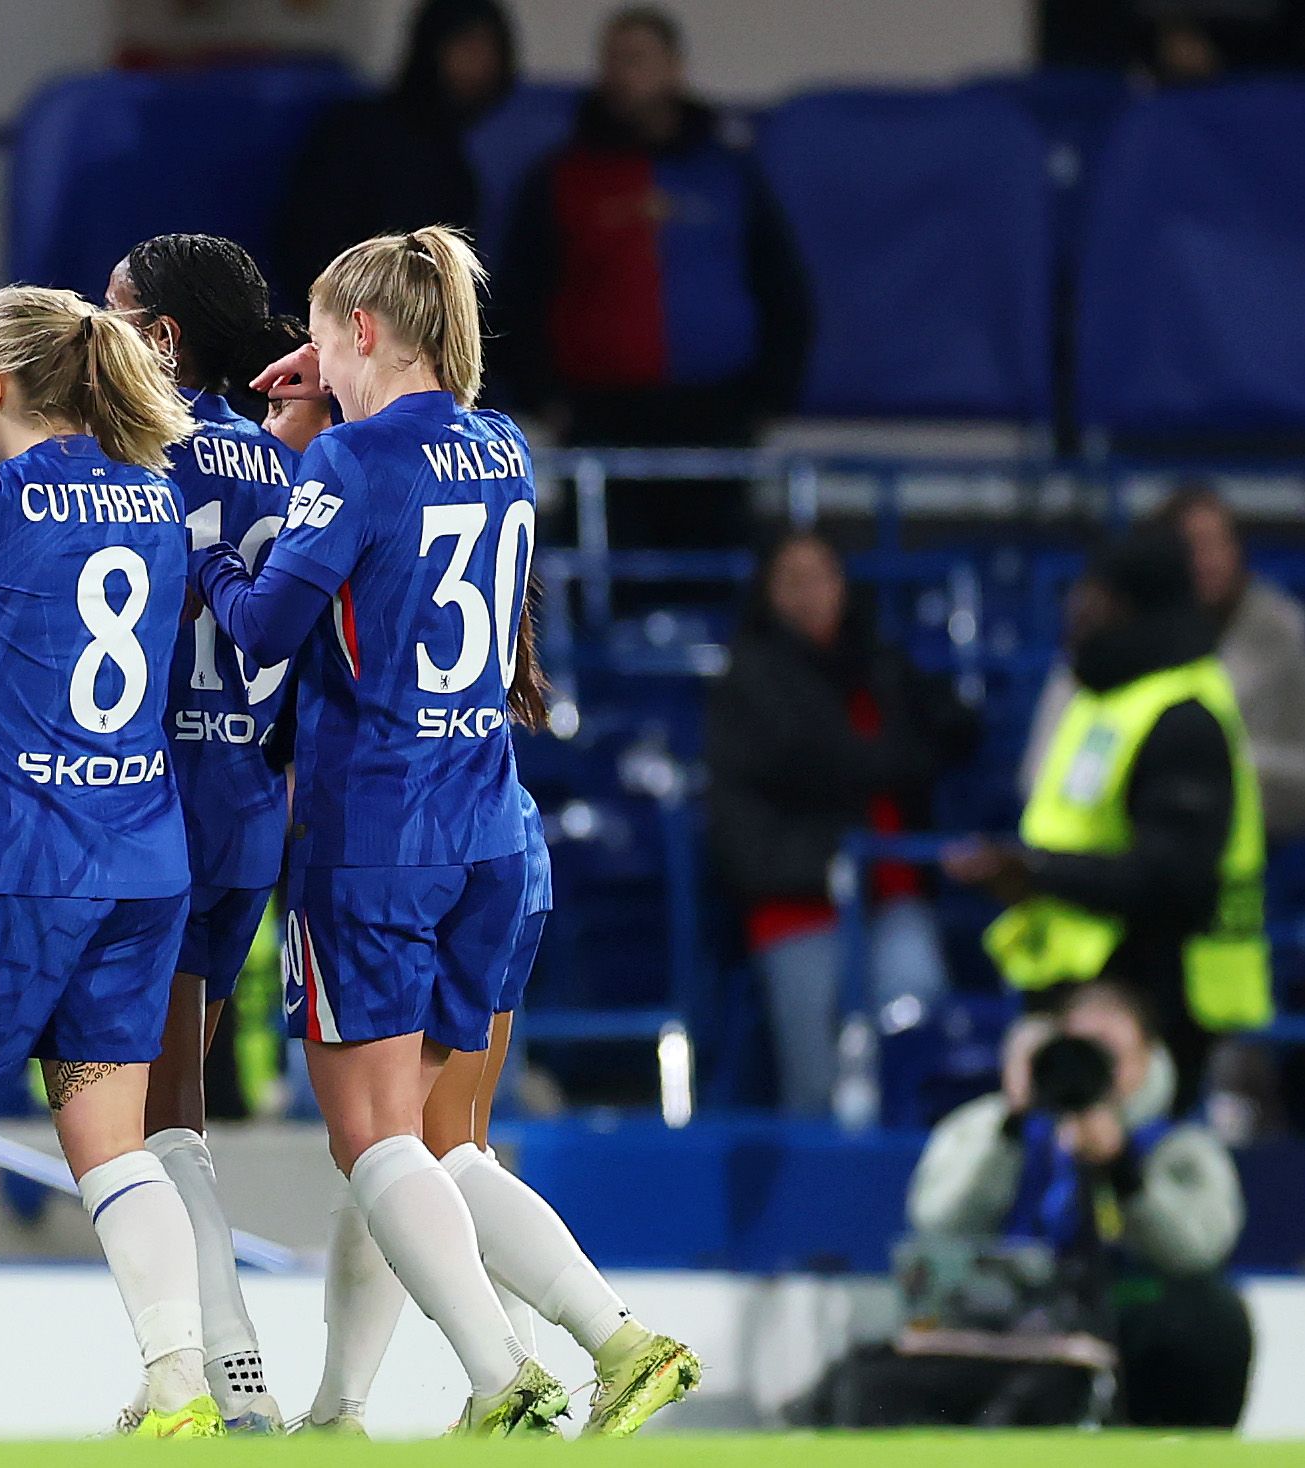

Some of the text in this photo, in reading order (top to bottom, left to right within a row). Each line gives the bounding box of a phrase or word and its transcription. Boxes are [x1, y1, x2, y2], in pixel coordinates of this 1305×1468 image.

[193, 436, 290, 487] GIRMA
[421, 439, 526, 482] WALSH
[416, 500, 535, 693] 30
[70, 546, 149, 733] 8
[18, 750, 165, 786] SKODA
